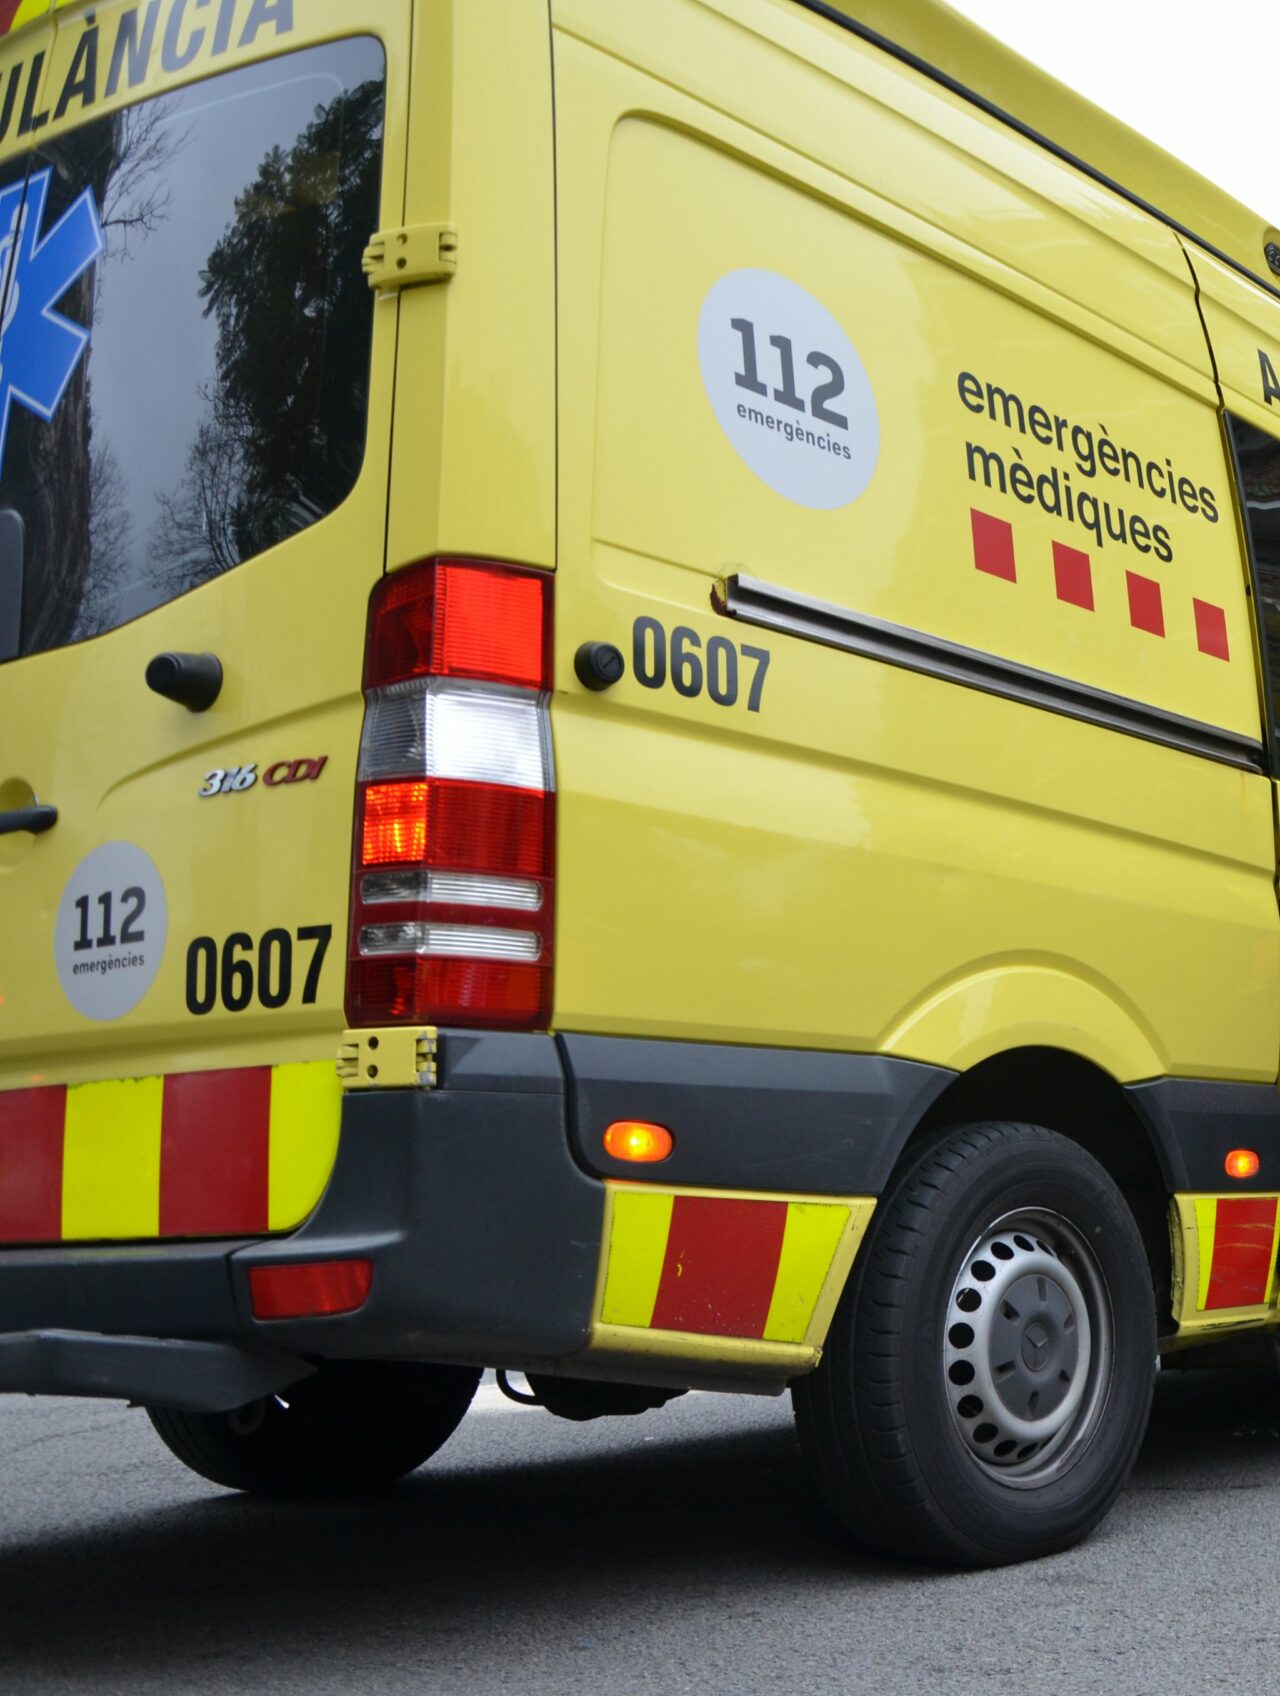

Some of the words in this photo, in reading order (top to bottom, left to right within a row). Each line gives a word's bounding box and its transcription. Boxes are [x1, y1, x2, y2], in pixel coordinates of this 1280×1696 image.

[730, 318, 849, 431] 112
[736, 403, 852, 460] emergències
[957, 371, 1219, 523] emergències
[964, 440, 1173, 563] mèdiques
[632, 615, 770, 713] 0607
[198, 763, 258, 798] 316
[262, 755, 328, 787] CDI
[73, 886, 146, 951] 112
[73, 951, 145, 975] emergències
[186, 924, 332, 1015] 0607
